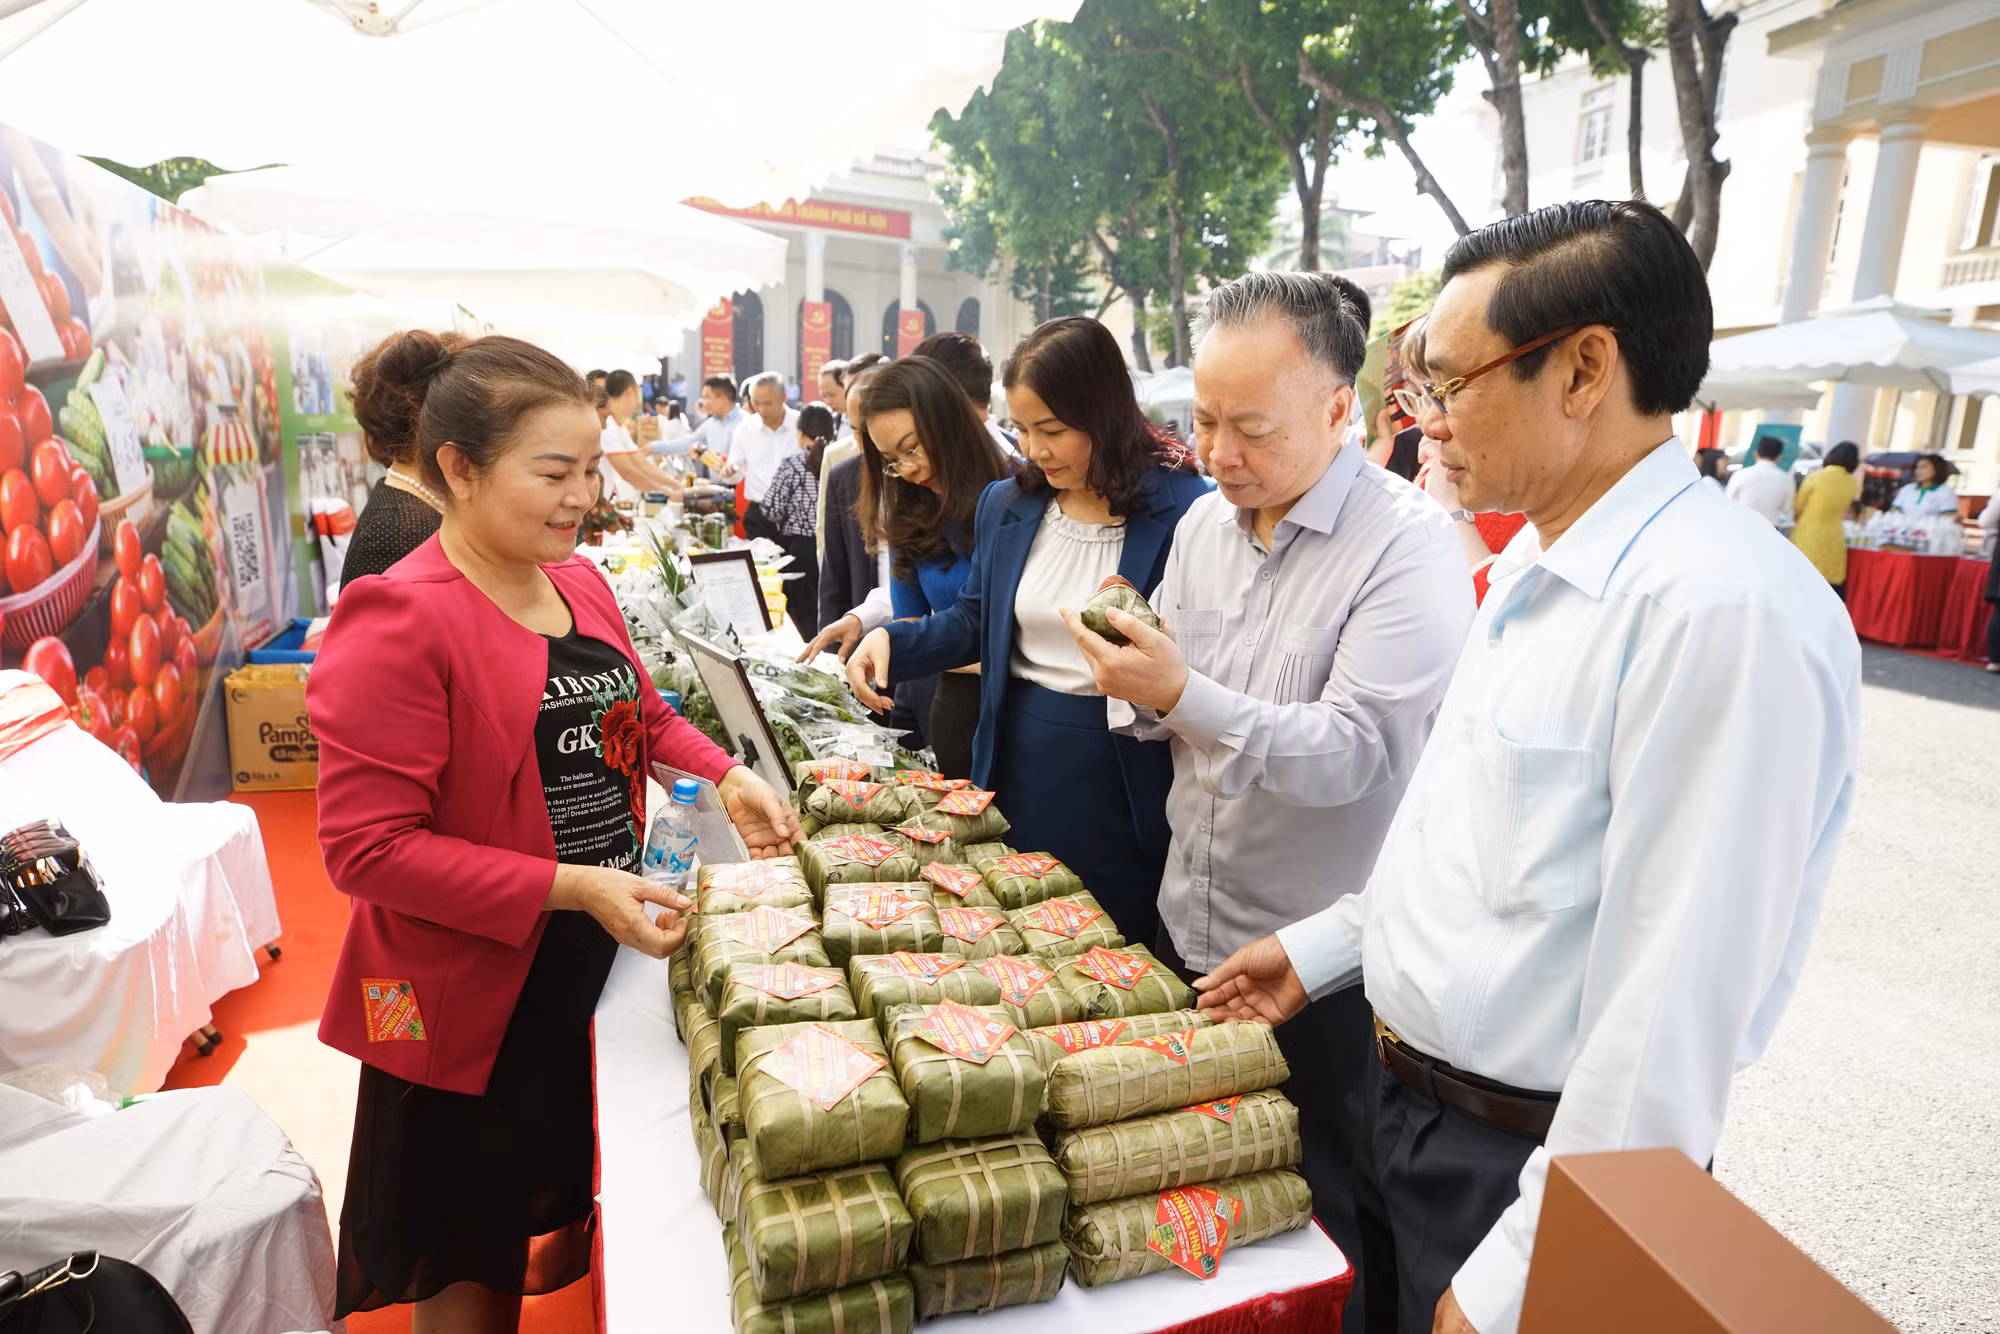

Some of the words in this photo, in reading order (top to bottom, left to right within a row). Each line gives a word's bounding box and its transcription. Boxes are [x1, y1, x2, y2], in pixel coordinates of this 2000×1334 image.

[540, 697, 576, 711] FASHION
[576, 696, 583, 704] IN
[583, 695, 594, 703] THE
[560, 775, 572, 783] The
[573, 772, 594, 781] balloon
[544, 785, 562, 793] There
[573, 780, 597, 788] moments
[566, 797, 576, 805] you
[577, 794, 588, 803] just
[551, 806, 567, 814] from
[568, 803, 580, 812] your
[581, 800, 600, 809] dreams
[555, 812, 570, 820] real!
[571, 809, 589, 817] Dream
[586, 821, 605, 830] enough
[568, 838, 588, 847] sorrow
[594, 833, 606, 842] keep
[568, 847, 584, 856] make
[584, 844, 595, 853] you
